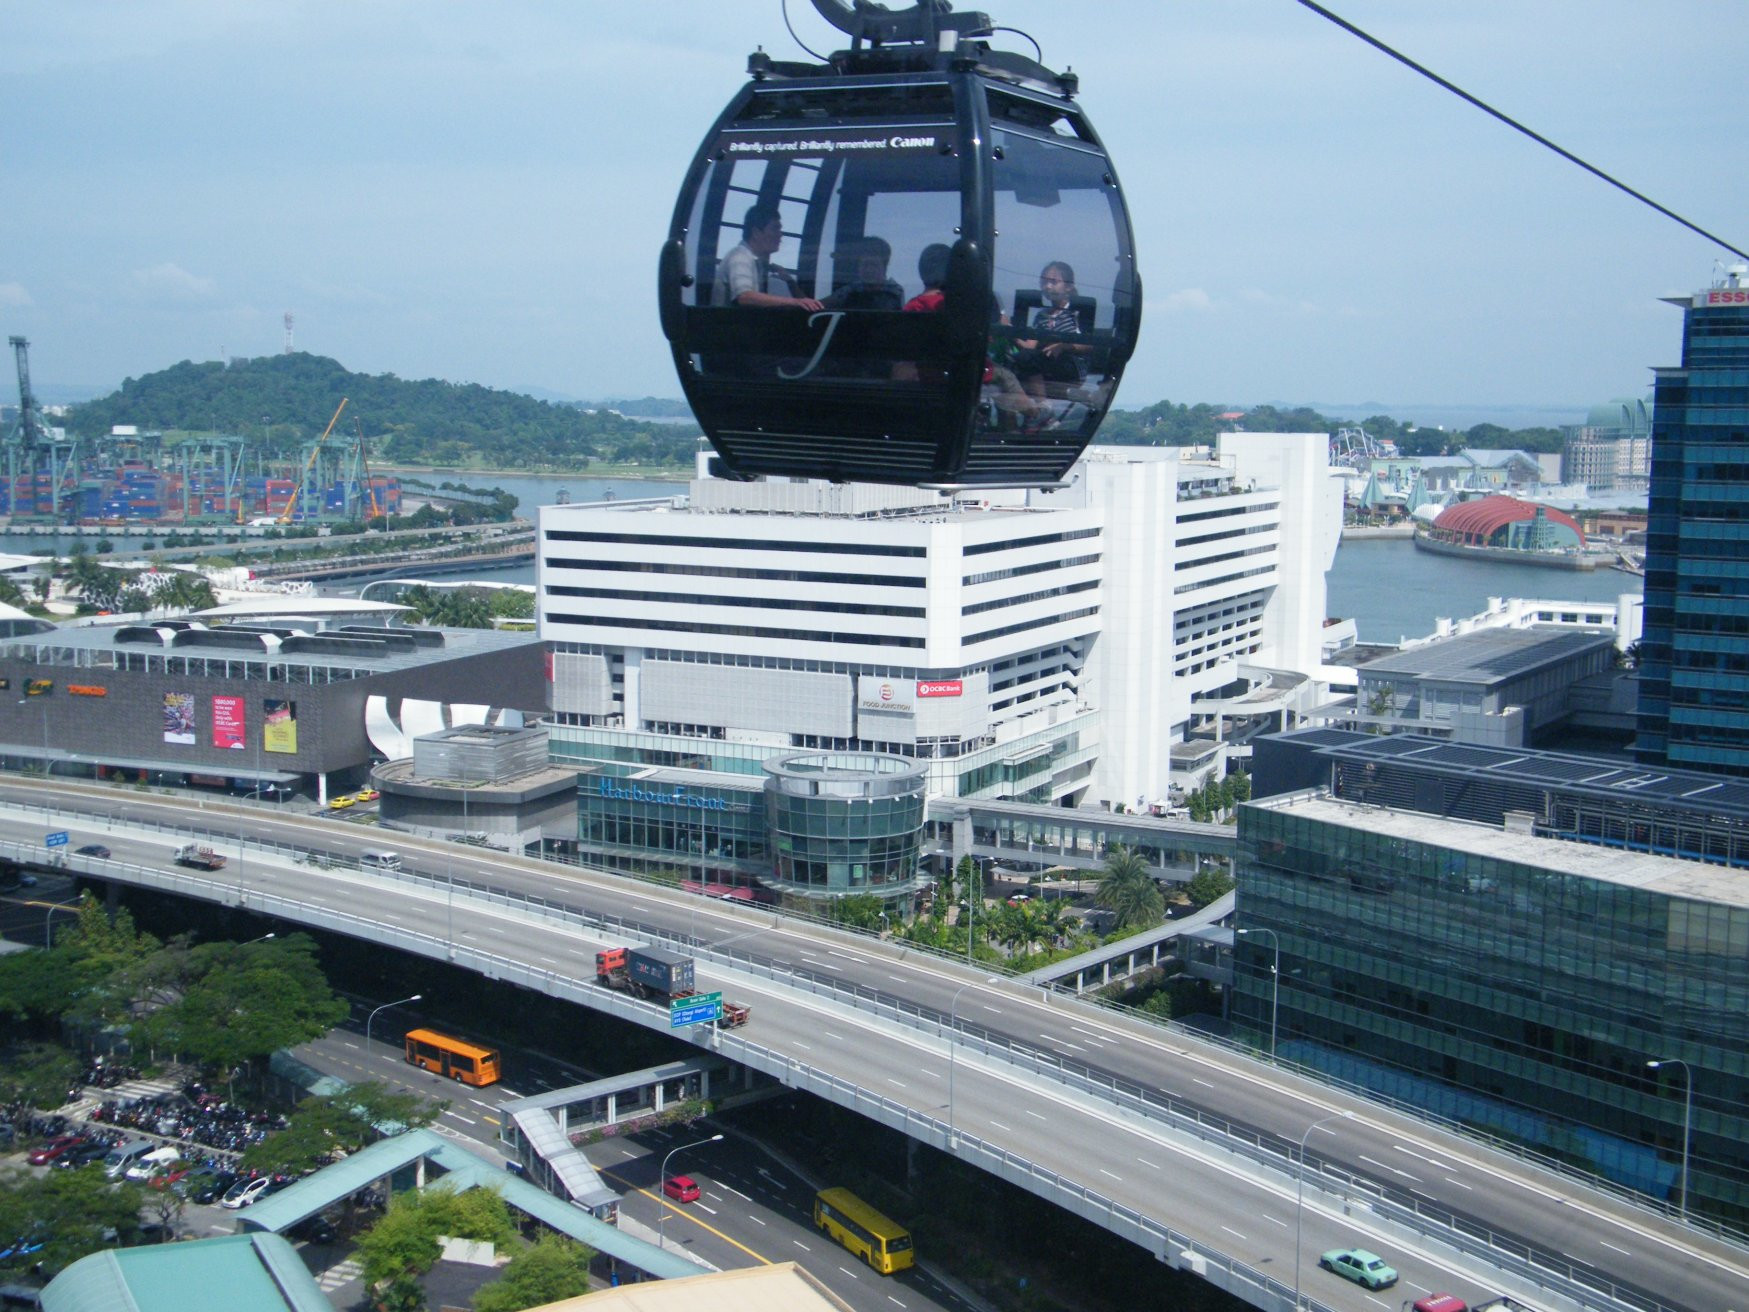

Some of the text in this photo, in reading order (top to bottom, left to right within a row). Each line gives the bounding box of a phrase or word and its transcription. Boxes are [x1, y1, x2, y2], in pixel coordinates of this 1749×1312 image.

[890, 136, 935, 148] Canon
[947, 684, 961, 692] Bank
[863, 700, 911, 711] FOOD JUNCTION
[599, 776, 728, 811] HarbourFront
